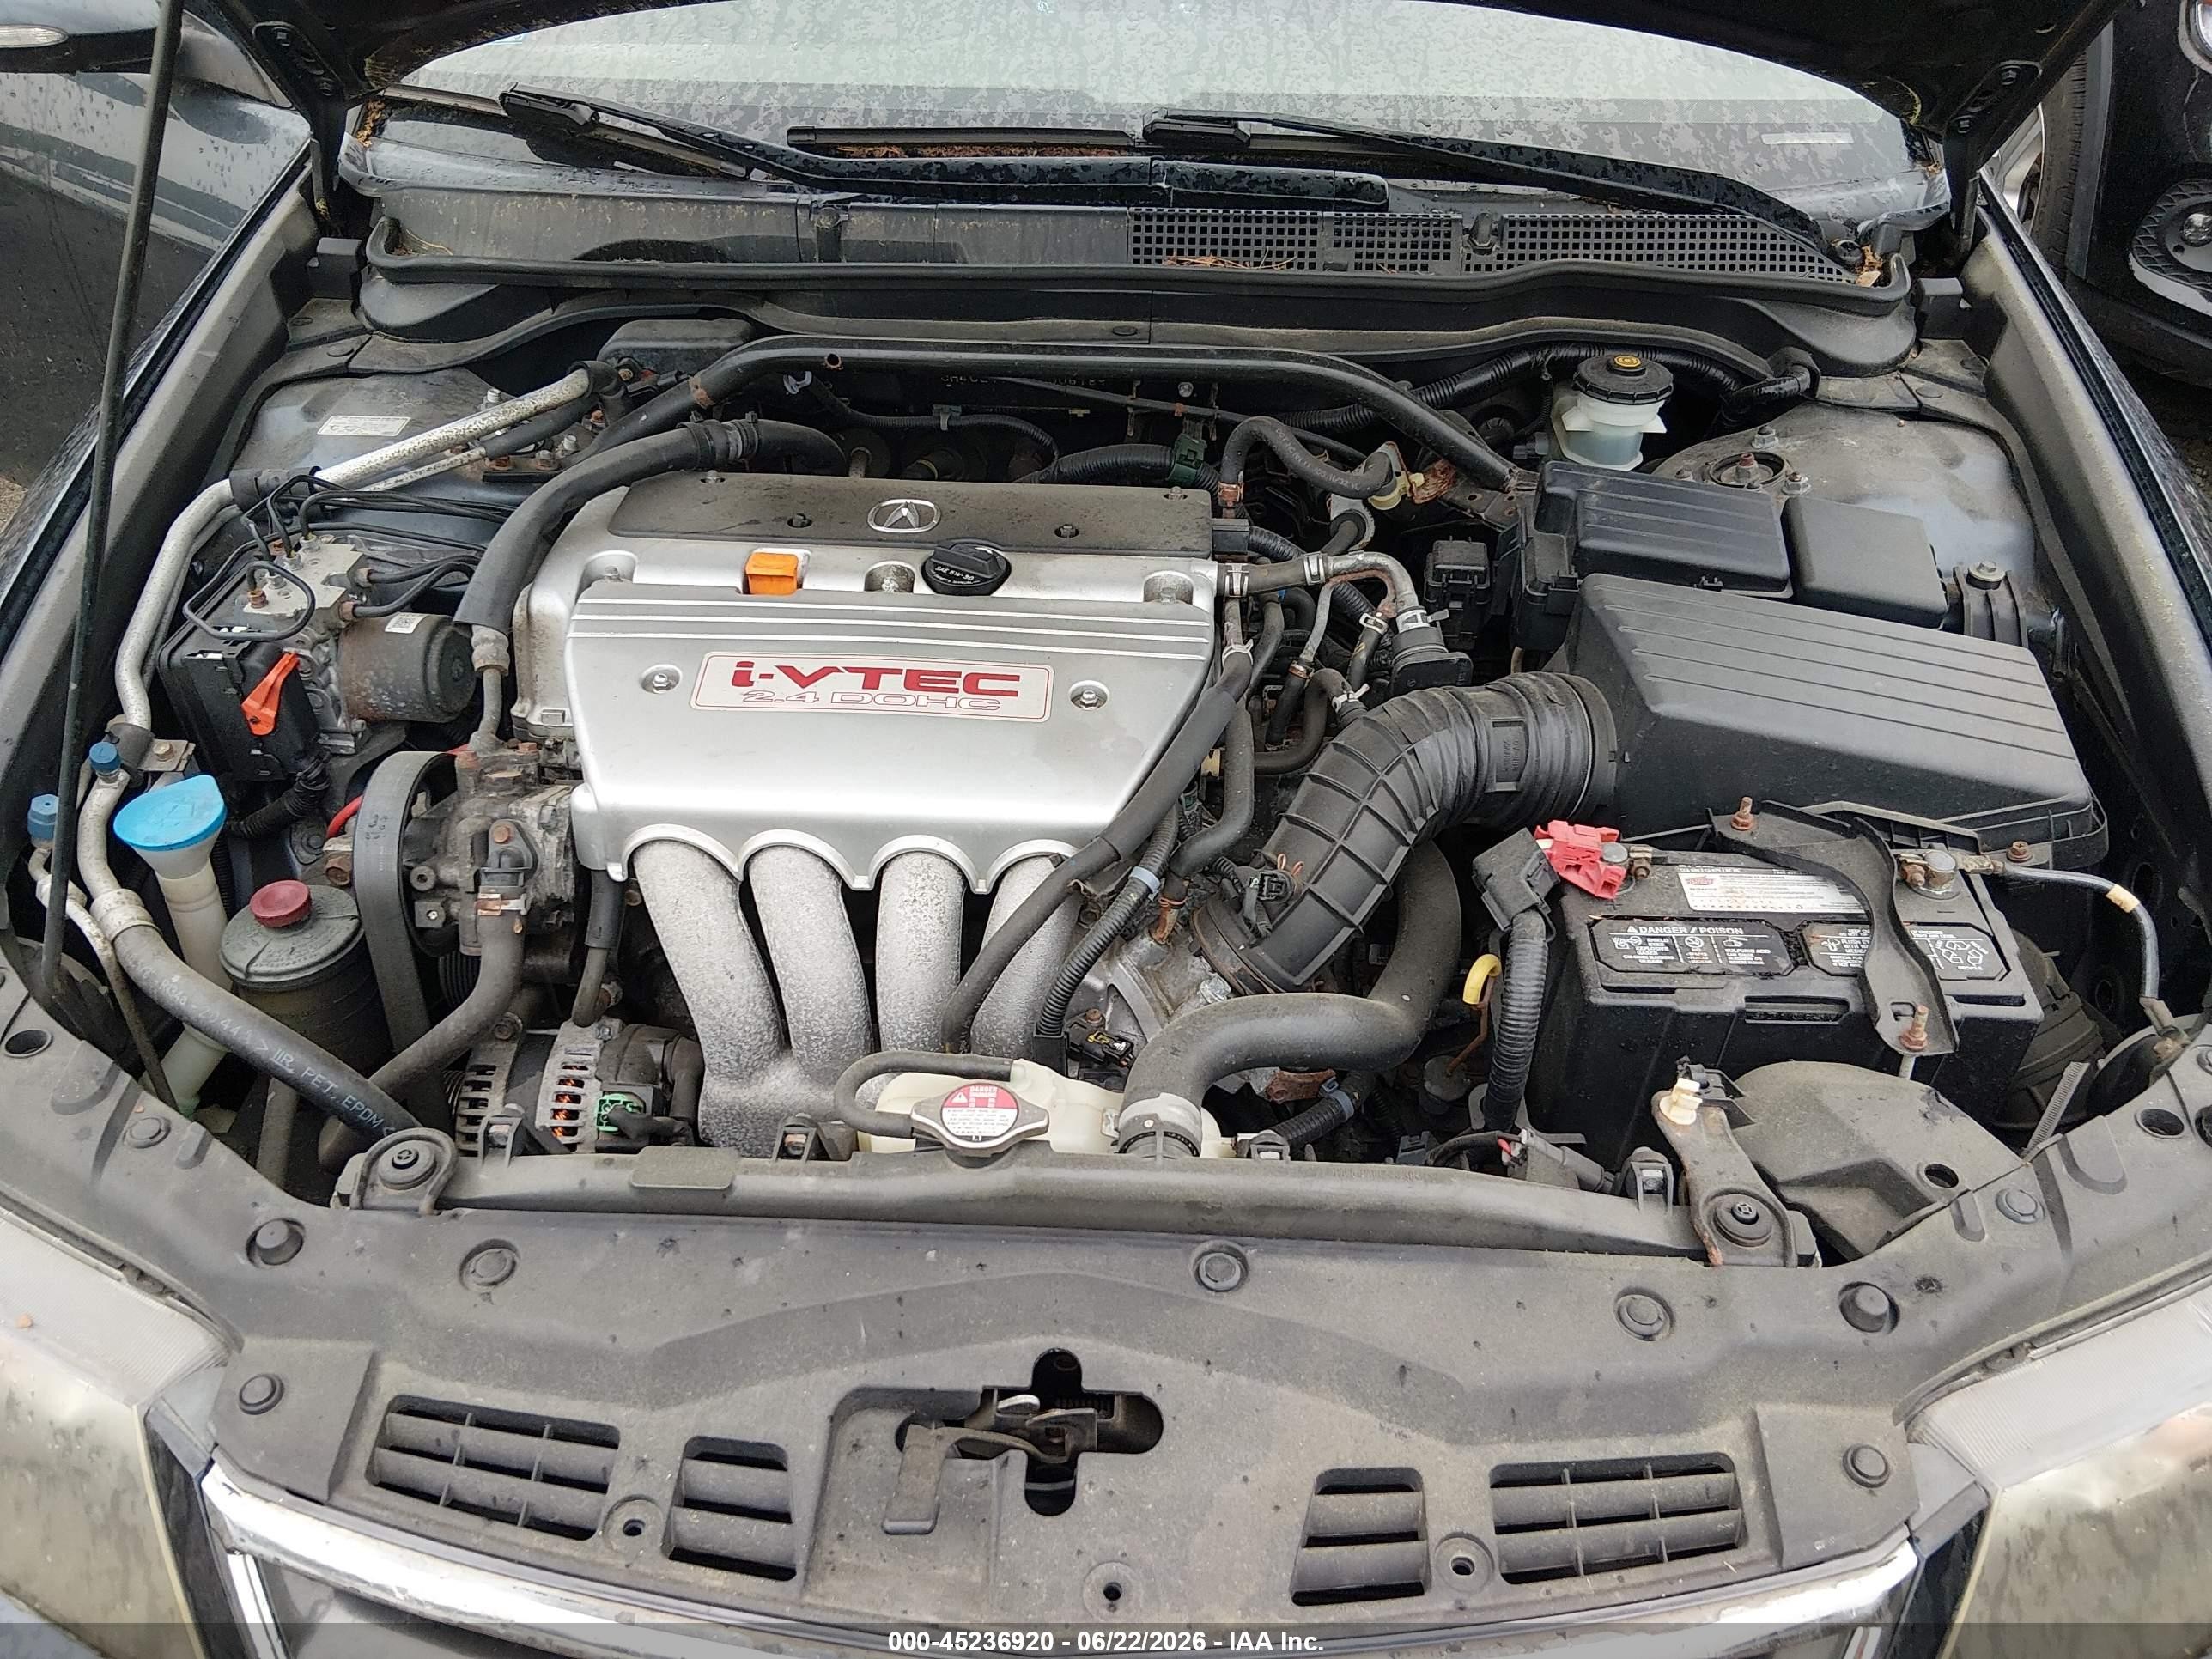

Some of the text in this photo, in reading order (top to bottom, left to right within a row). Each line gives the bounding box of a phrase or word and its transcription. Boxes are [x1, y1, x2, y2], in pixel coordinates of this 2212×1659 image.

[732, 661, 1021, 697] i-VTEC
[741, 690, 1001, 711] 2.4 DOHC
[342, 1094, 385, 1128] EPDM
